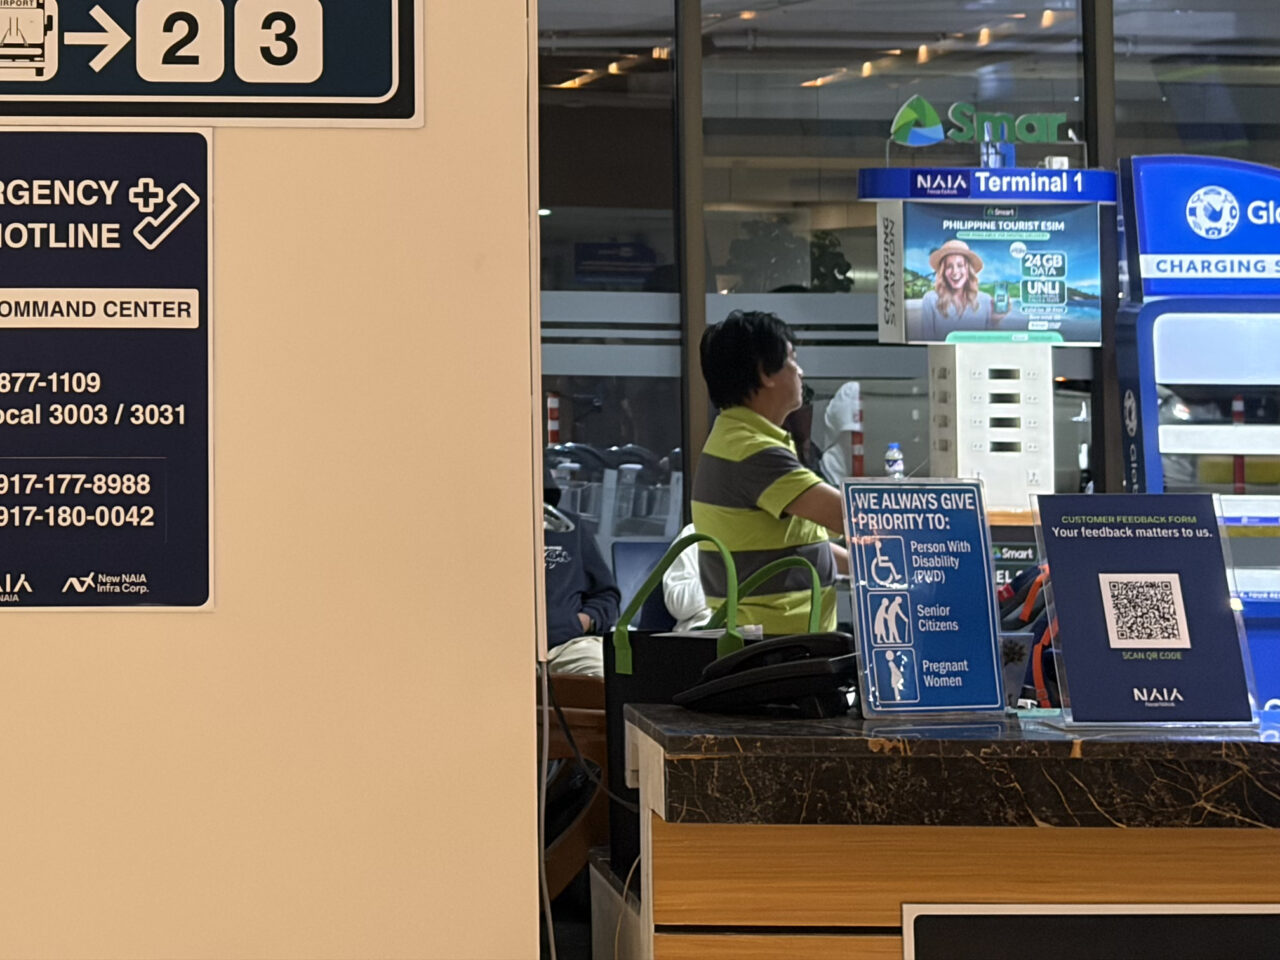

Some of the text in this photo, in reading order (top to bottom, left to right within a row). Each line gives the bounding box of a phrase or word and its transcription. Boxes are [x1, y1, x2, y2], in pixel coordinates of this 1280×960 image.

[161, 11, 298, 66] 2 3
[917, 171, 1082, 193] NAIA Terminal 1
[1247, 200, 1280, 225] Gl
[943, 220, 1065, 231] PHILIPPINE TOURIST ESIM
[1030, 267, 1056, 275] DATA
[1156, 259, 1266, 273] CHARGING
[1027, 281, 1059, 294] UNLI
[103, 301, 191, 318] CENTER
[49, 405, 108, 425] 3003
[114, 404, 124, 425] /
[130, 405, 184, 425] 3031
[855, 493, 975, 509] WE ALWAYS GIVE
[858, 513, 950, 530] PRIORITY TO:
[1052, 526, 1213, 537] Your feedback matters to us.
[910, 541, 971, 552] Person With
[1002, 547, 1033, 559] Smart
[912, 555, 959, 569] Disability
[98, 574, 147, 583] New NAIA
[914, 570, 945, 584] (PWD)
[97, 583, 149, 594] Infra Corp.
[917, 604, 950, 616] Senior
[918, 619, 959, 631] Citizens
[1122, 651, 1182, 660] SCAN QR CODE
[922, 659, 969, 674] Pregnant
[923, 675, 962, 687] Women
[1133, 688, 1184, 701] NAIA
